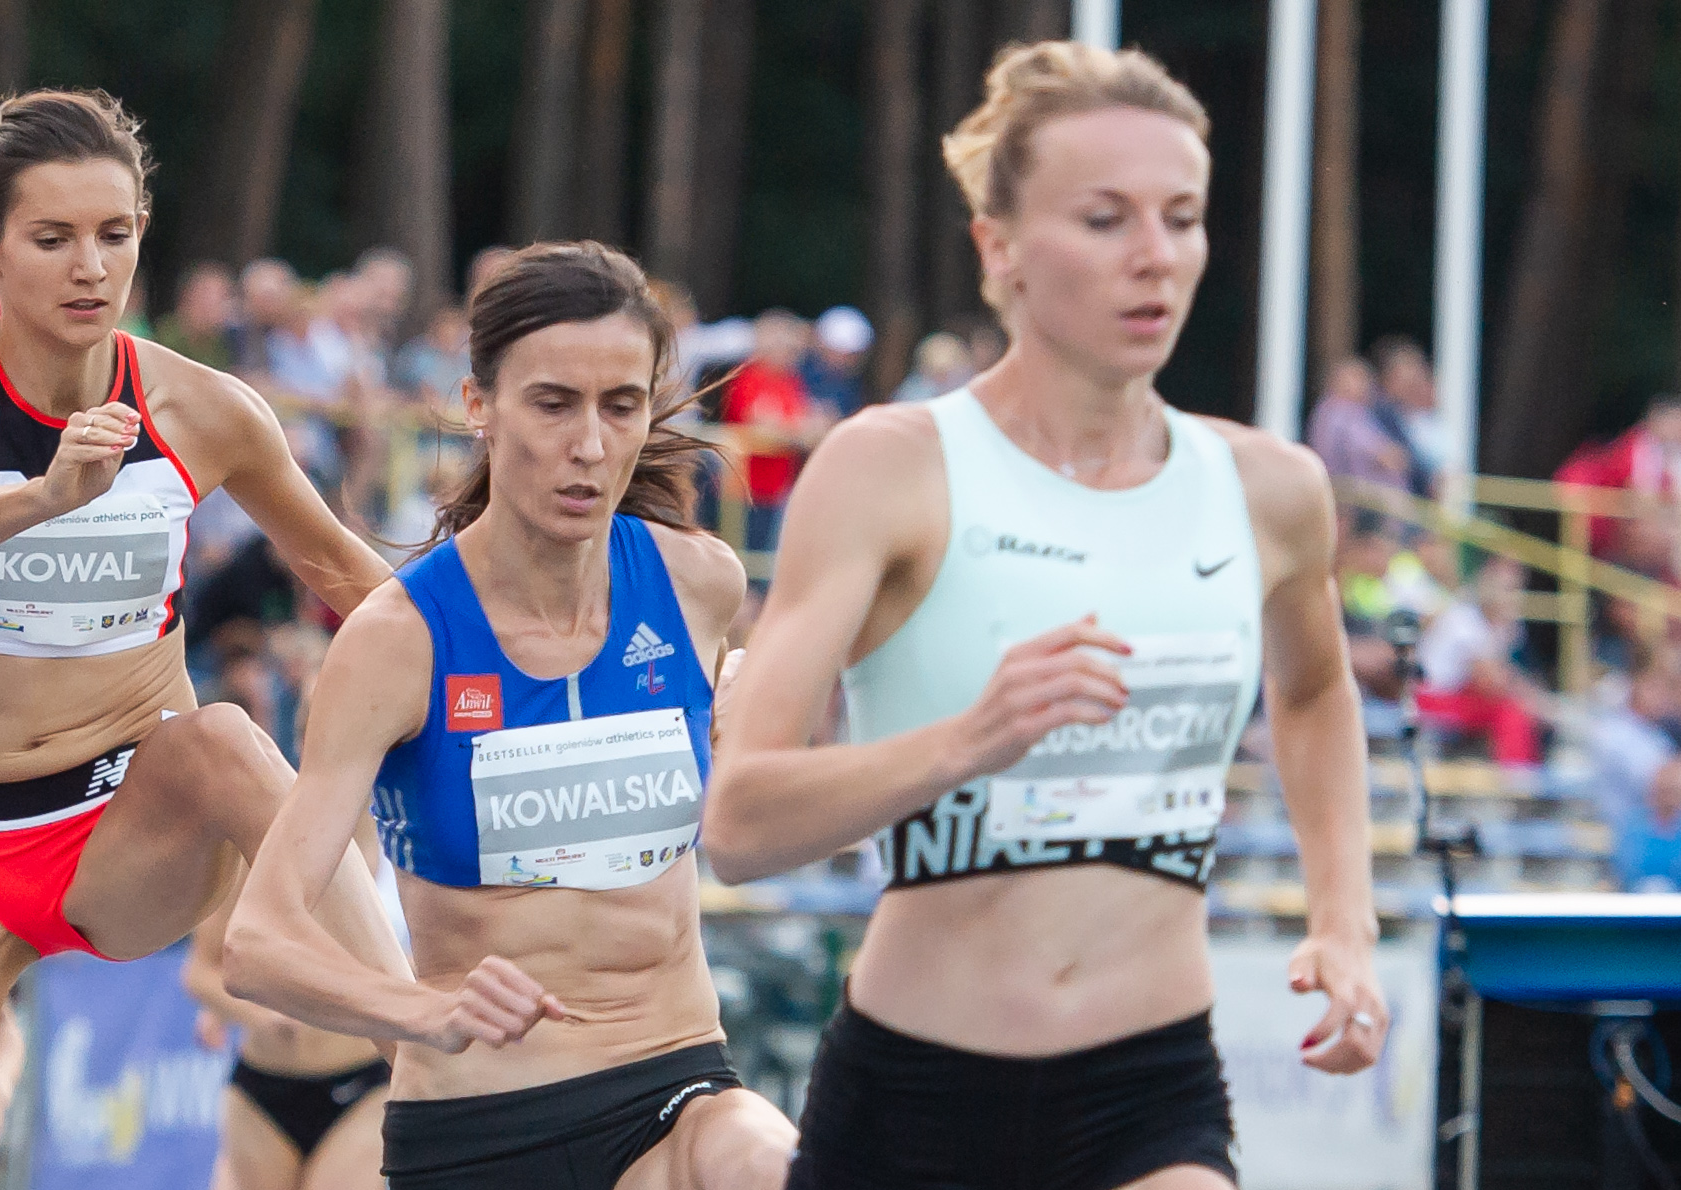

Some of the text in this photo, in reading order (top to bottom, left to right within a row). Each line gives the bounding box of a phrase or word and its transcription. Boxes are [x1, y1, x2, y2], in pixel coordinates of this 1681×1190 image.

[92, 511, 137, 523] athletics
[140, 511, 165, 522] park
[622, 643, 675, 667] adidas
[478, 727, 683, 762] BESTSELLER goleniów athletics park
[490, 769, 698, 831] KOWALSKA
